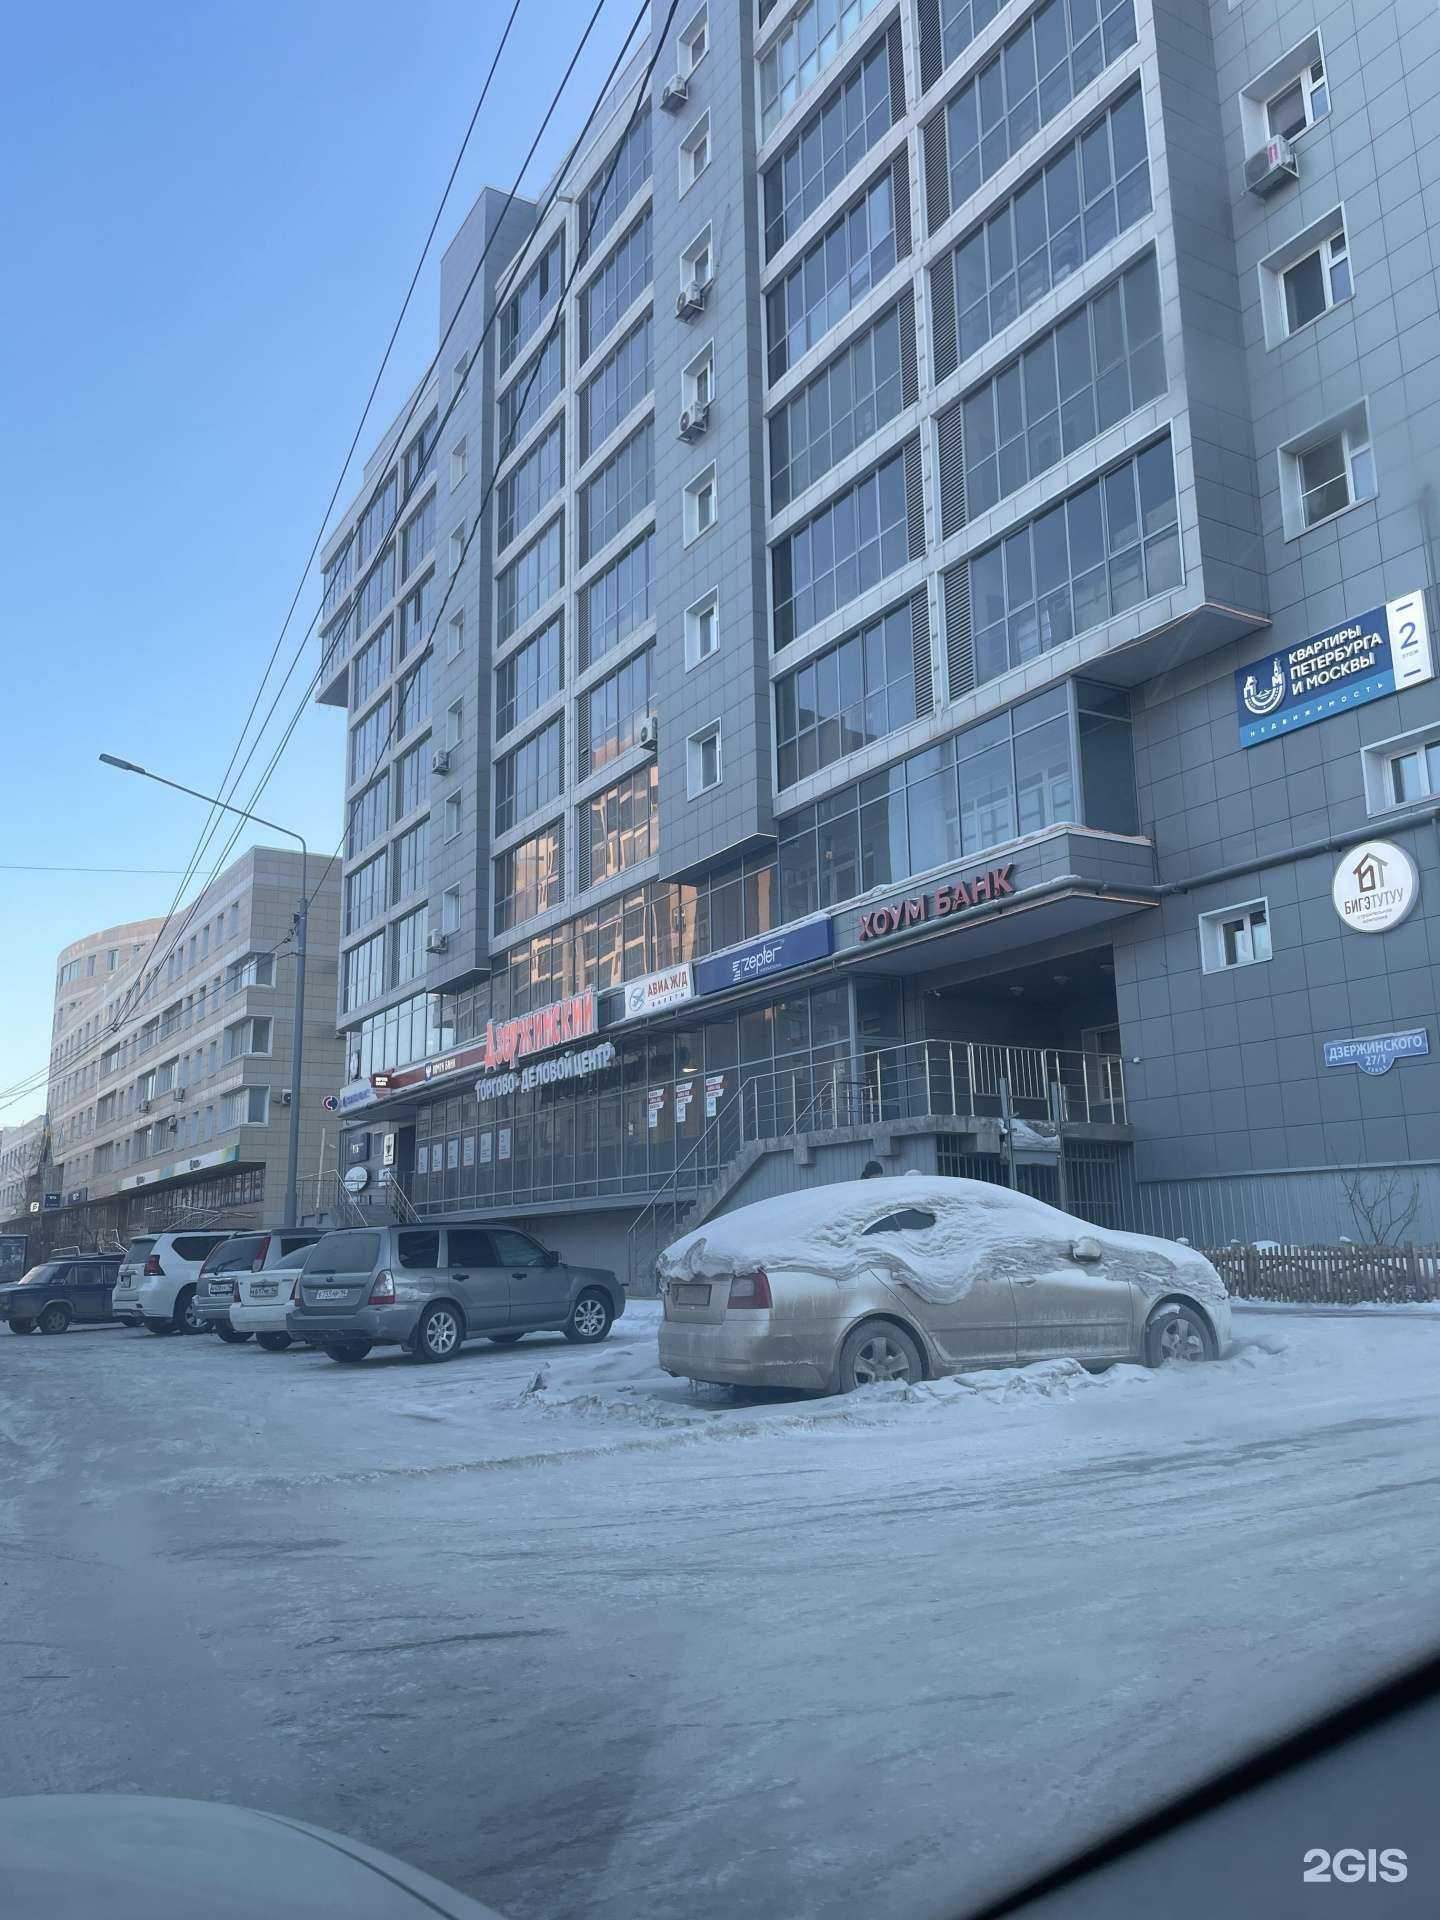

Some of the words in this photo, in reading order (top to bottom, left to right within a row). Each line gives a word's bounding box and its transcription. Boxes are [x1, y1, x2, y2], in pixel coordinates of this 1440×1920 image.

[1288, 625, 1361, 664] КВАРТИРЫ
[1399, 622, 1418, 649] 2
[1290, 632, 1383, 680] ПЕТЕРБУРГА
[1292, 680, 1304, 696] И
[1306, 653, 1376, 691] МОСКВЫ
[1250, 682, 1384, 737] НЕДВИЖИМОСТЬ
[859, 893, 928, 941] ХОУМ
[935, 862, 1016, 916] БАНК
[1344, 888, 1404, 915] БИГЭТУТУУ
[647, 977, 669, 998] АВИА
[670, 971, 688, 989] Ж/Д
[573, 1042, 616, 1078] ЦЕНТР
[1328, 1036, 1423, 1062] ДЗЕРЖИНСКОГО
